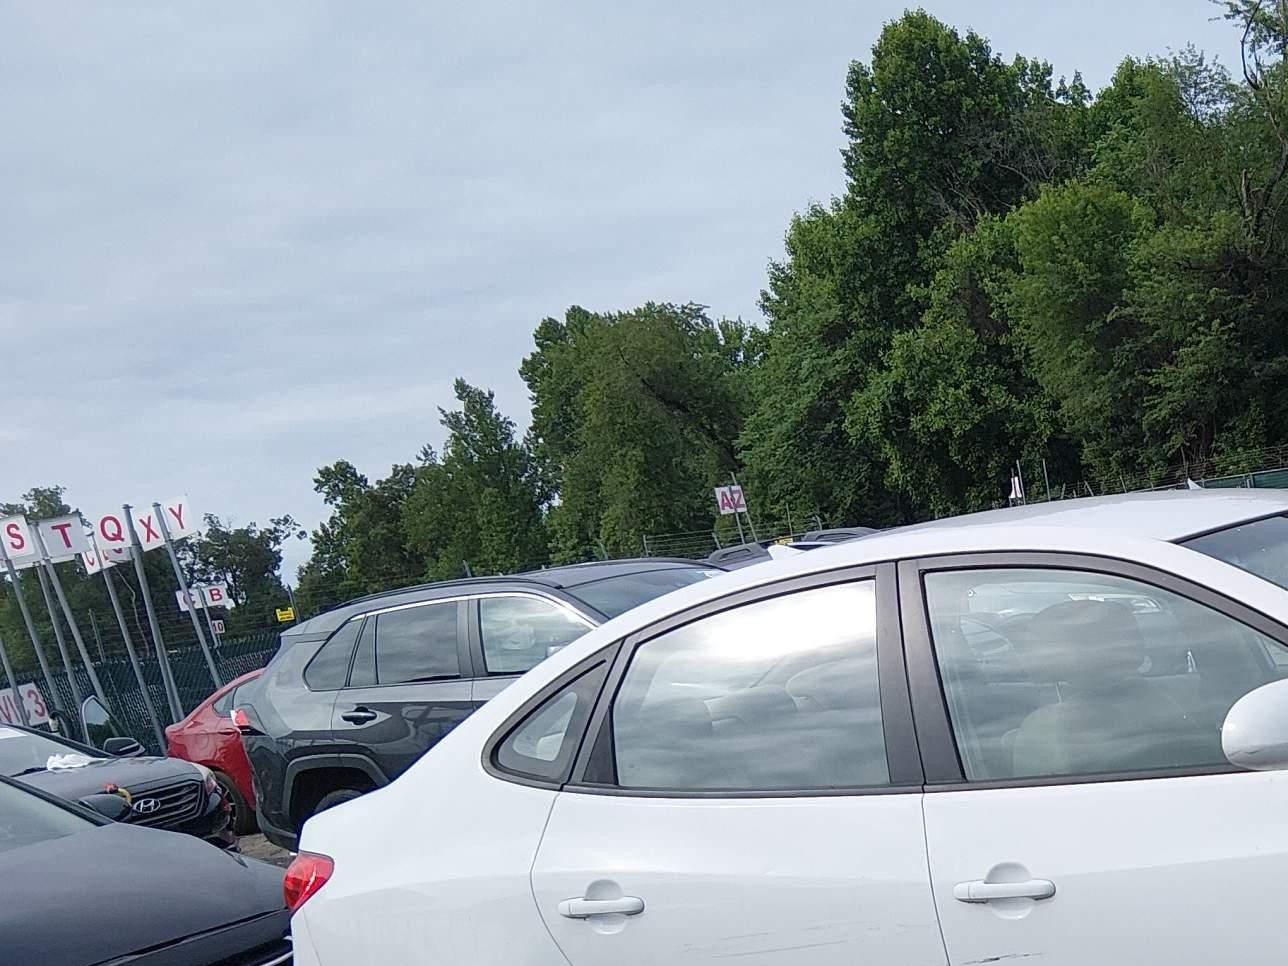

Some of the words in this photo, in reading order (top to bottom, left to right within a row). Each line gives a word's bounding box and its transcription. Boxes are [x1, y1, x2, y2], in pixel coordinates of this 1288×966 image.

[100, 516, 125, 542] Q
[139, 515, 160, 543] X
[169, 504, 185, 529] Y
[6, 523, 25, 550] S
[51, 523, 73, 549] T
[208, 588, 223, 602] B
[212, 622, 224, 632] 10
